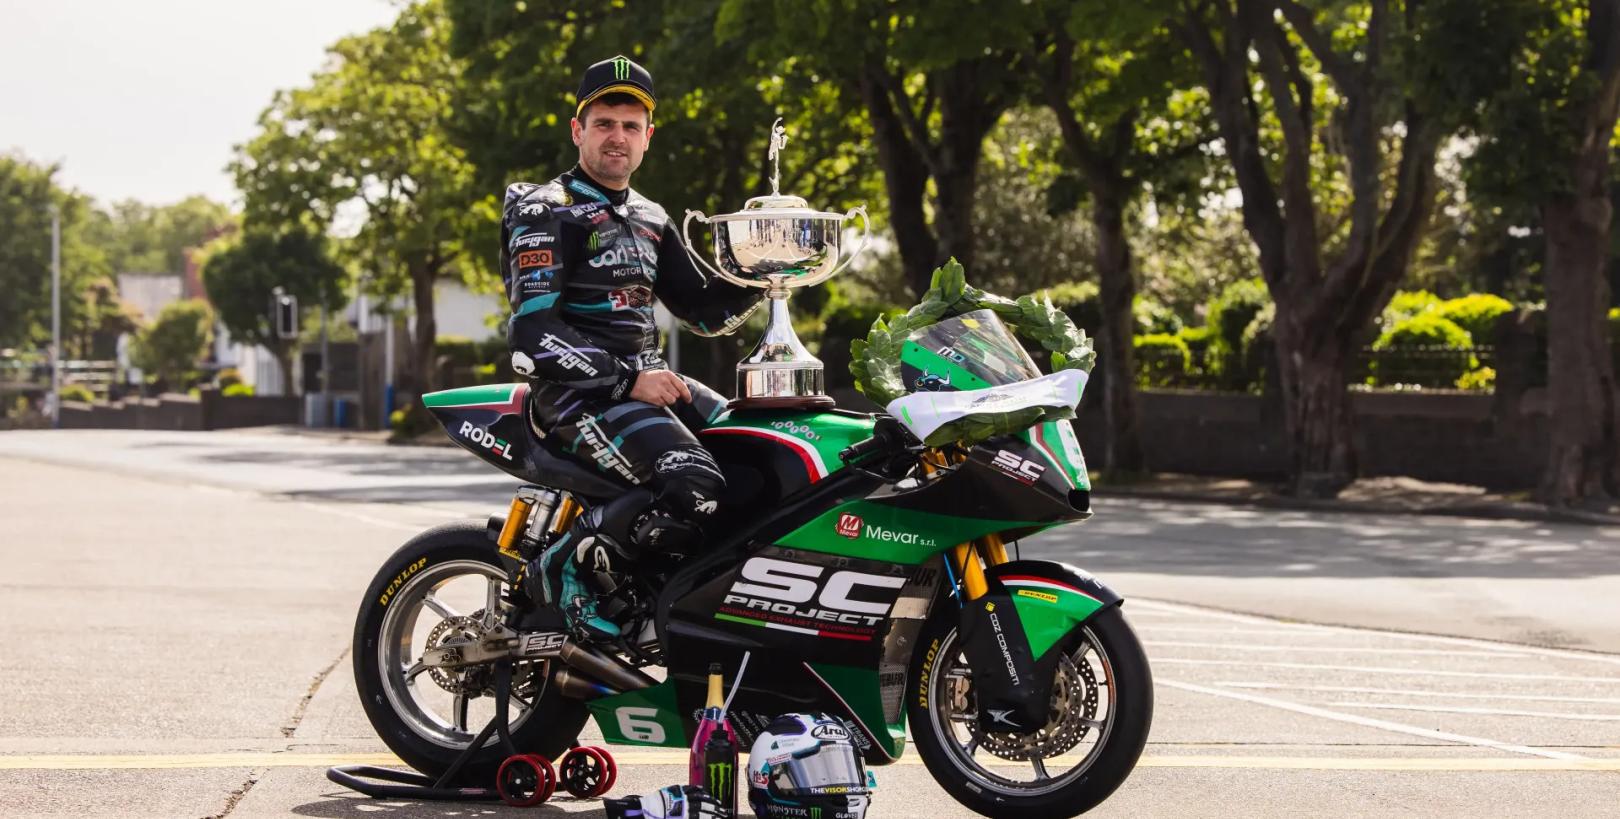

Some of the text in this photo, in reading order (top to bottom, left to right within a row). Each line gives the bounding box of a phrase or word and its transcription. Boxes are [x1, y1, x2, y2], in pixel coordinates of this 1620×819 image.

[991, 460, 1037, 483] PROJECT
[994, 449, 1047, 479] SC
[866, 525, 919, 546] Mevar
[379, 557, 428, 606] DUNLOP
[730, 556, 907, 616] SC
[723, 594, 884, 626] PROJECT
[527, 635, 568, 648] SC
[919, 638, 939, 710] DUNLOP
[615, 706, 666, 744] 6
